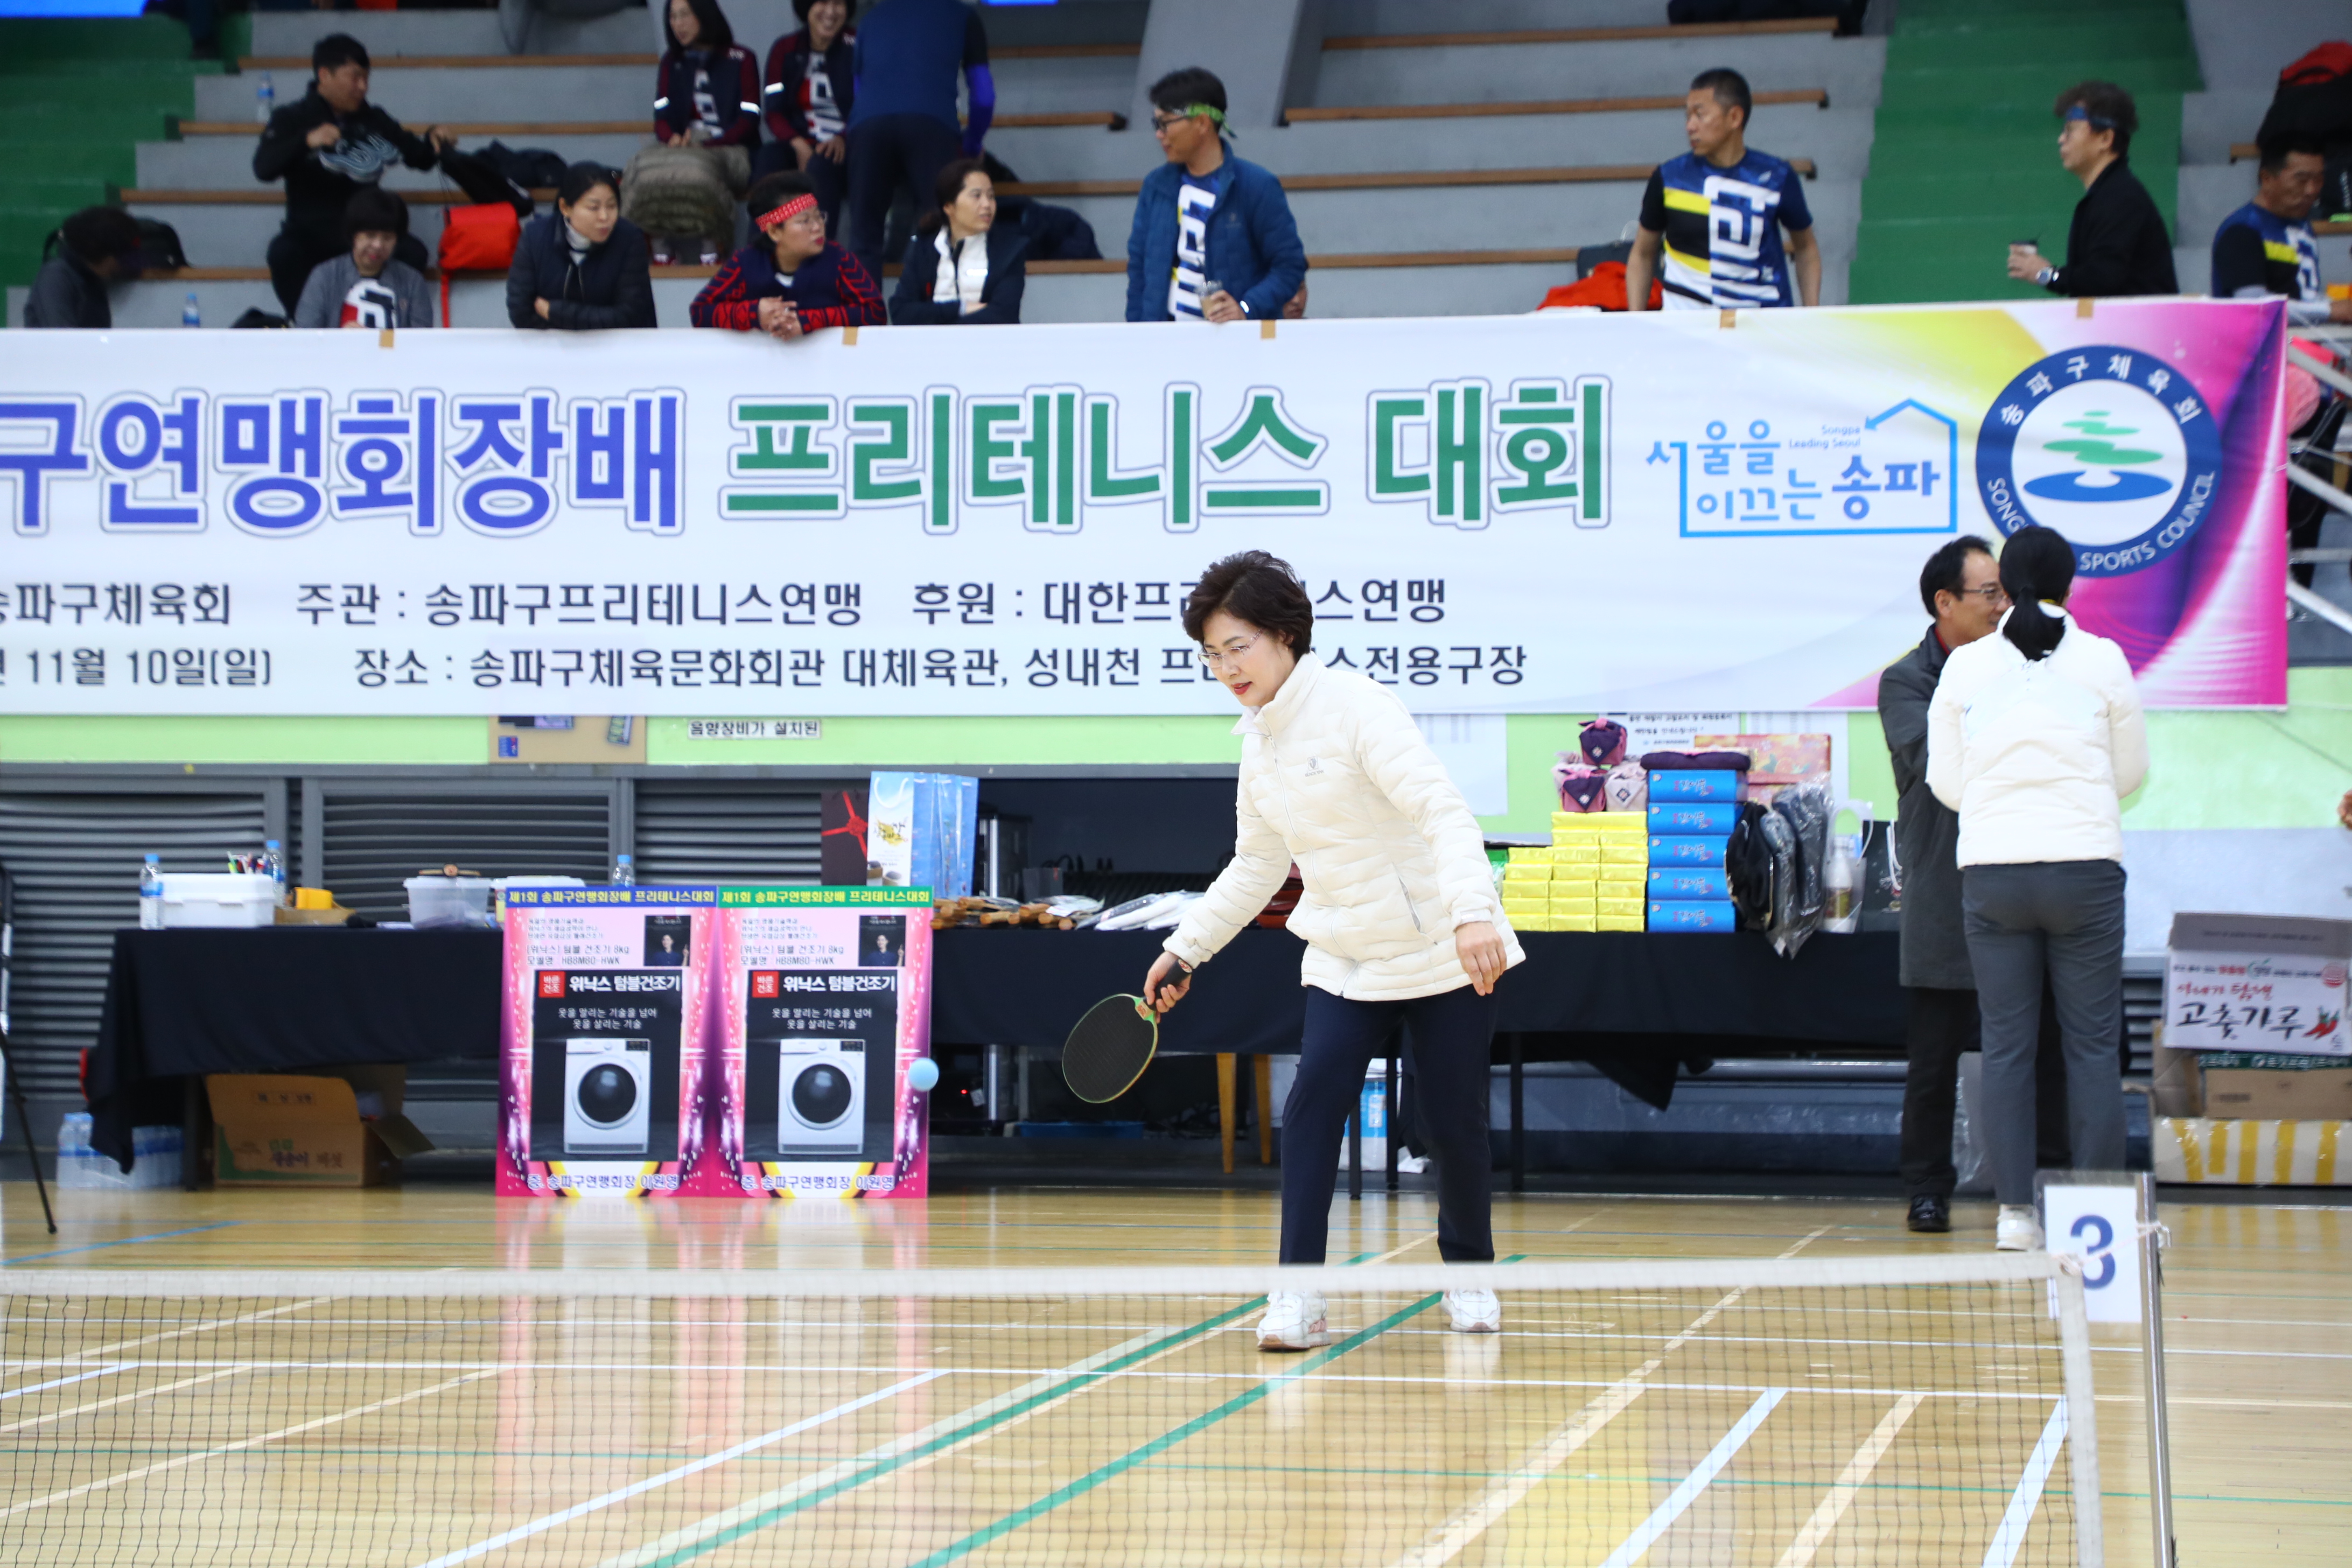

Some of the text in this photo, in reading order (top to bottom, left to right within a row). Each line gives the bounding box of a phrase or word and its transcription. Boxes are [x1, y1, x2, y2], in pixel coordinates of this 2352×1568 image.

[2000, 354, 2202, 425] 송파구체육회
[1822, 425, 1860, 436] Songpa
[1646, 419, 1781, 475] 서울을
[1789, 437, 1861, 450] Leading Seoul
[0, 380, 1606, 533] 구연맹회장배 프리테니스 대회
[1697, 454, 1941, 521] 이끄는 송파
[1987, 470, 2216, 571] SONG SPORTS COUNCIL
[0, 583, 229, 625] 파구체육회
[296, 583, 380, 625] 주관
[424, 583, 862, 626] 송파구프리테니스연맹
[913, 582, 995, 625] 후원
[1044, 579, 1446, 625] 대한프스연맹
[27, 648, 104, 686] 11월
[354, 649, 429, 687] 장소
[470, 648, 825, 688] 송파구체육문화회관
[844, 648, 1008, 688] 대체육관,
[1025, 648, 1140, 688] 성내천
[1161, 646, 1527, 686] 프스전용구장
[509, 891, 714, 903] 제1회 송파구연맹회장배 프리테니스대회
[722, 891, 930, 903] 제1회 송파구연맹회장배 프리테니스대회
[584, 944, 611, 954] 건조기
[799, 945, 825, 954] 건조기
[569, 975, 681, 992] 위닉스 텀블건조기
[783, 975, 895, 992] 위닉스 텀블건조기
[624, 1019, 643, 1030] 기술
[838, 1019, 857, 1030] 기술
[2175, 1001, 2305, 1040] 고춧가루
[547, 1174, 636, 1189] 송파구연맹회장
[761, 1175, 851, 1190] 송파구연맹회장
[2070, 1215, 2116, 1289] 3
